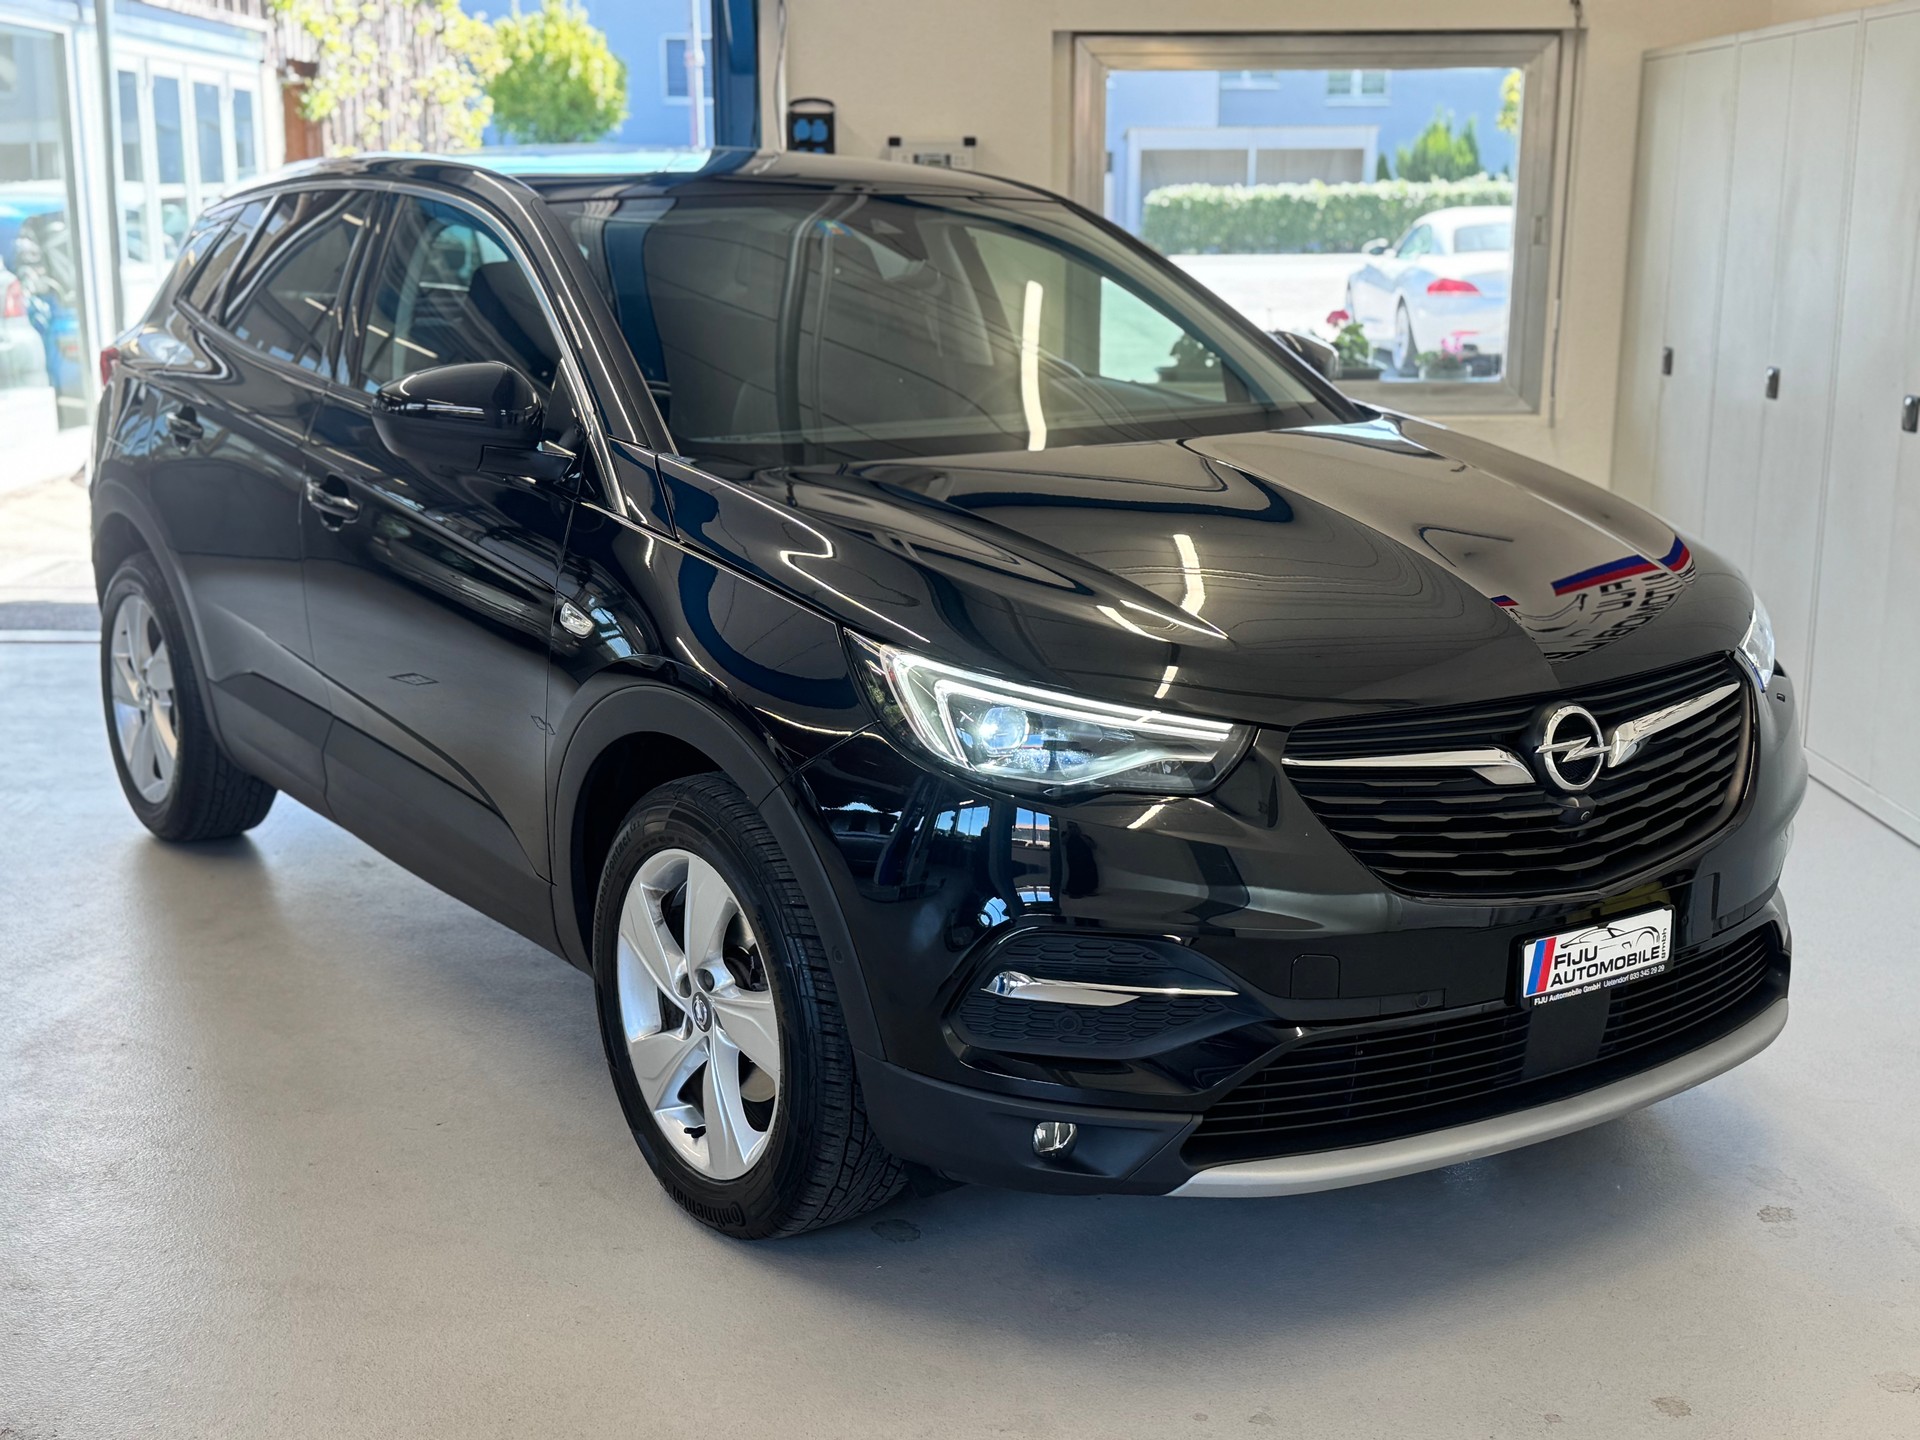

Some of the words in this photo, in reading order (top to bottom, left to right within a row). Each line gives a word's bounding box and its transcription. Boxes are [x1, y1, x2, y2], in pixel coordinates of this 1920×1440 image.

[1550, 945, 1660, 987] AUTOMOBILE
[1553, 946, 1598, 970] FIJU
[1534, 995, 1548, 1006] FIJU
[1549, 987, 1582, 1002] Automobile
[1583, 981, 1601, 993] GmbH
[1650, 965, 1657, 975] 29
[1657, 964, 1665, 973] 29
[672, 1184, 746, 1228] Continental
